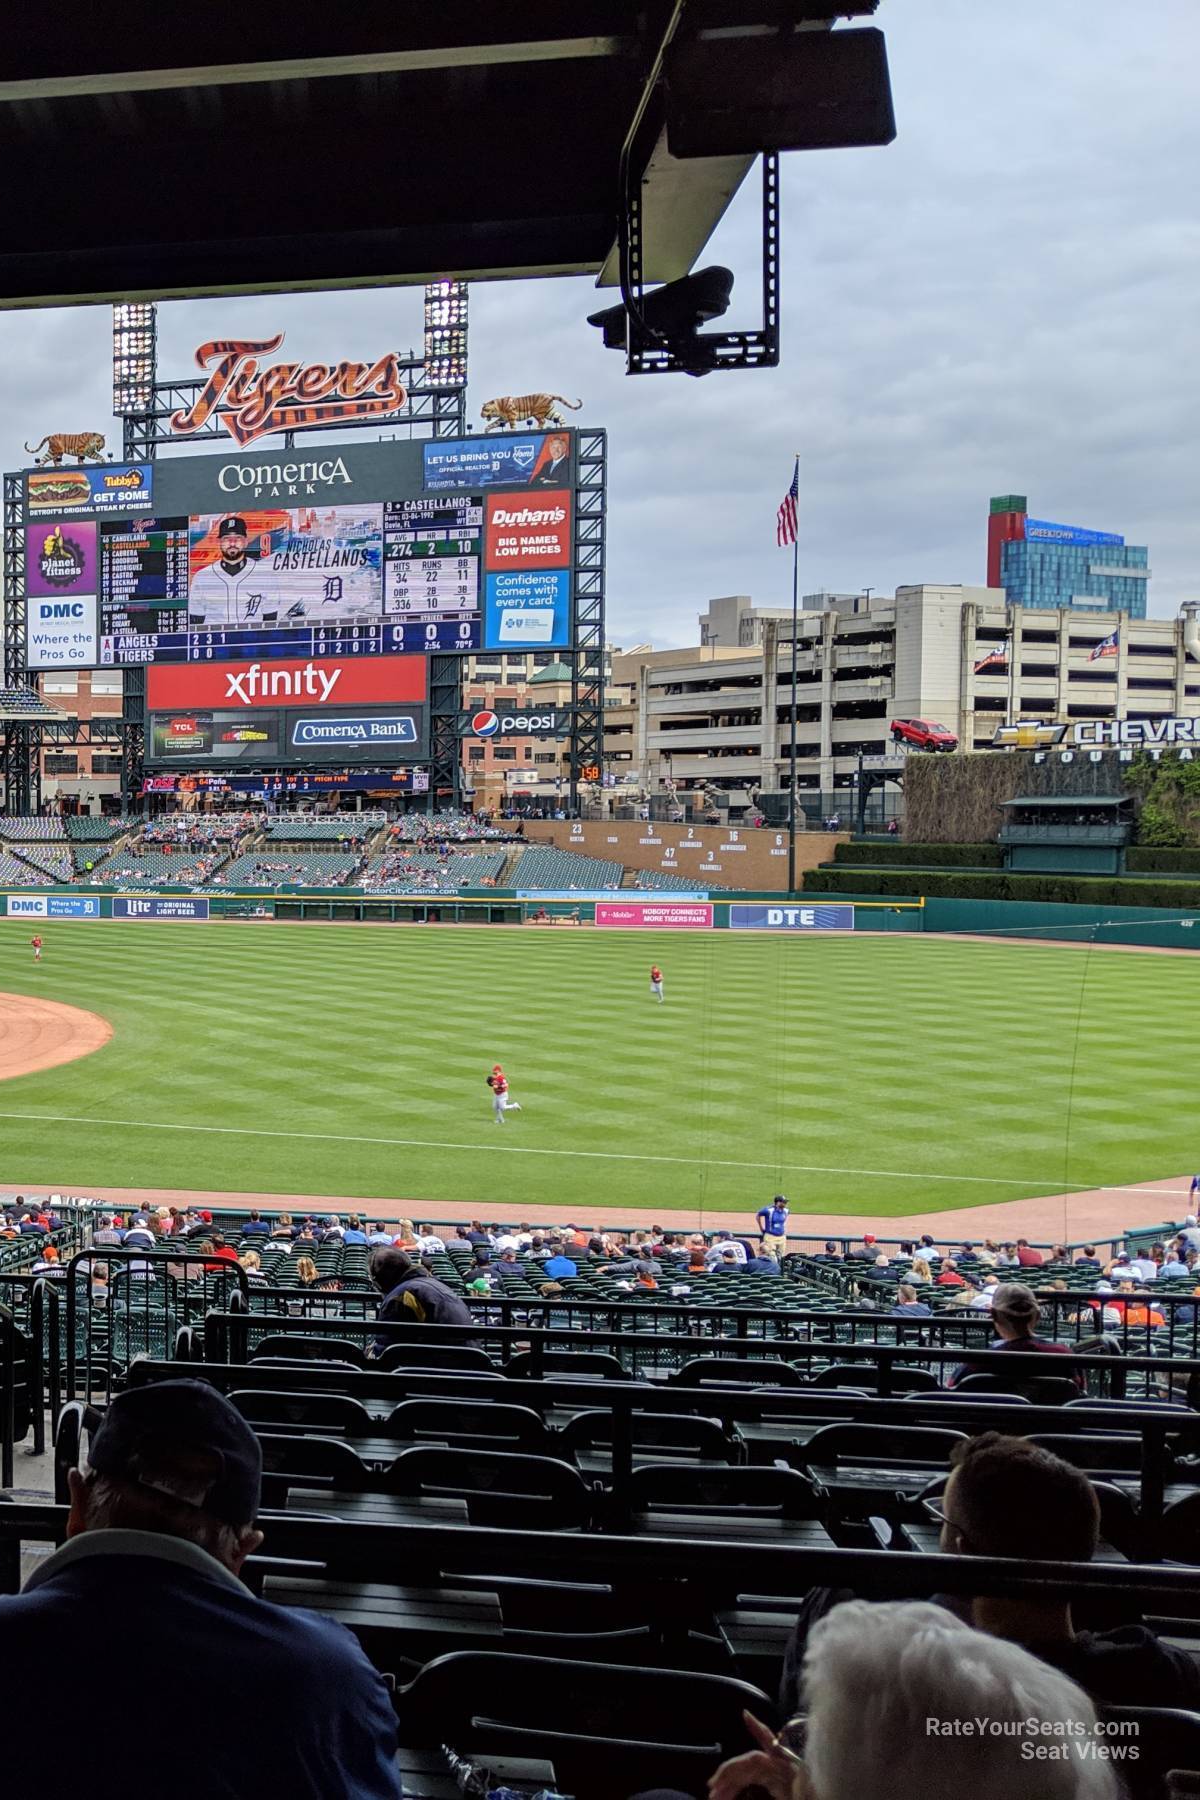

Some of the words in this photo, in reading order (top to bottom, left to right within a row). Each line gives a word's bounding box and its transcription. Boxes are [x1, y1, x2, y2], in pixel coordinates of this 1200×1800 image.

[170, 329, 407, 448] Tigers
[427, 456, 443, 465] LET
[446, 455, 458, 463] US
[461, 453, 488, 462] BRING
[491, 451, 510, 459] YOU
[104, 475, 140, 488] Tubby's
[93, 493, 115, 503] GET
[118, 490, 149, 501] SOME
[254, 484, 315, 498] PARK
[29, 508, 62, 516] DETROIT'S
[64, 506, 94, 514] ORIGINAL
[96, 504, 117, 512] STEAK
[127, 502, 152, 510] CHEESE
[387, 502, 392, 512] 9
[404, 497, 471, 511] CASTELLANOS
[492, 506, 566, 525] Dunham's
[458, 530, 471, 538] RBI
[498, 537, 517, 546] BIG
[520, 535, 558, 545] NAMES
[260, 533, 271, 557] 9
[286, 539, 331, 553] NICHOLAS
[387, 544, 412, 557] .274
[428, 542, 435, 555] 2
[458, 540, 471, 553] 10
[495, 547, 519, 557] LOW
[521, 545, 561, 555] PRICES
[41, 558, 74, 570] planet
[272, 548, 368, 571] CASTELLANOS
[393, 562, 410, 571] HITS
[422, 560, 441, 569] RUNS
[458, 559, 468, 567] BB
[46, 567, 82, 576] fitness
[396, 573, 407, 583] 34
[426, 571, 437, 582] 22
[458, 569, 468, 580] 11
[496, 575, 558, 586] Confidence
[427, 587, 436, 595] 2B
[458, 585, 467, 593] 3B
[496, 587, 531, 596] comes
[534, 584, 558, 595] with
[392, 599, 411, 610] .336
[426, 598, 438, 609] 10
[460, 596, 466, 607] 2
[496, 597, 526, 608] every
[528, 595, 556, 606] card.
[40, 603, 84, 618] DMC
[118, 636, 158, 648] ANGELS
[193, 634, 199, 645] 2
[206, 634, 212, 644] 3
[220, 633, 226, 644] 1
[319, 628, 325, 639] 6
[336, 628, 342, 638] 7
[353, 627, 359, 638] 0
[369, 626, 376, 637] 0
[392, 626, 404, 642] 0
[426, 624, 437, 640] 0
[459, 622, 471, 639] 0
[32, 634, 69, 645] Where
[73, 633, 93, 643] the
[40, 649, 64, 660] Pros
[68, 648, 85, 659] Go
[118, 650, 154, 662] TIGERS
[336, 643, 342, 653] 2
[369, 641, 376, 651] 2
[224, 662, 342, 704] xfinity
[174, 723, 192, 731] TCL
[370, 722, 407, 736] Bank
[501, 713, 555, 733] pepsi
[1035, 748, 1193, 764] FOUNTA
[572, 824, 582, 834] 23
[648, 825, 653, 836] 5
[688, 828, 693, 839] 2
[729, 831, 738, 841] 16
[776, 834, 782, 846] 6
[665, 848, 675, 858] 47
[708, 851, 714, 861] 3
[364, 887, 458, 895] MotorCityCasino.com
[11, 900, 43, 912] DMC
[126, 900, 151, 915] Lite
[767, 908, 815, 925] DTE
